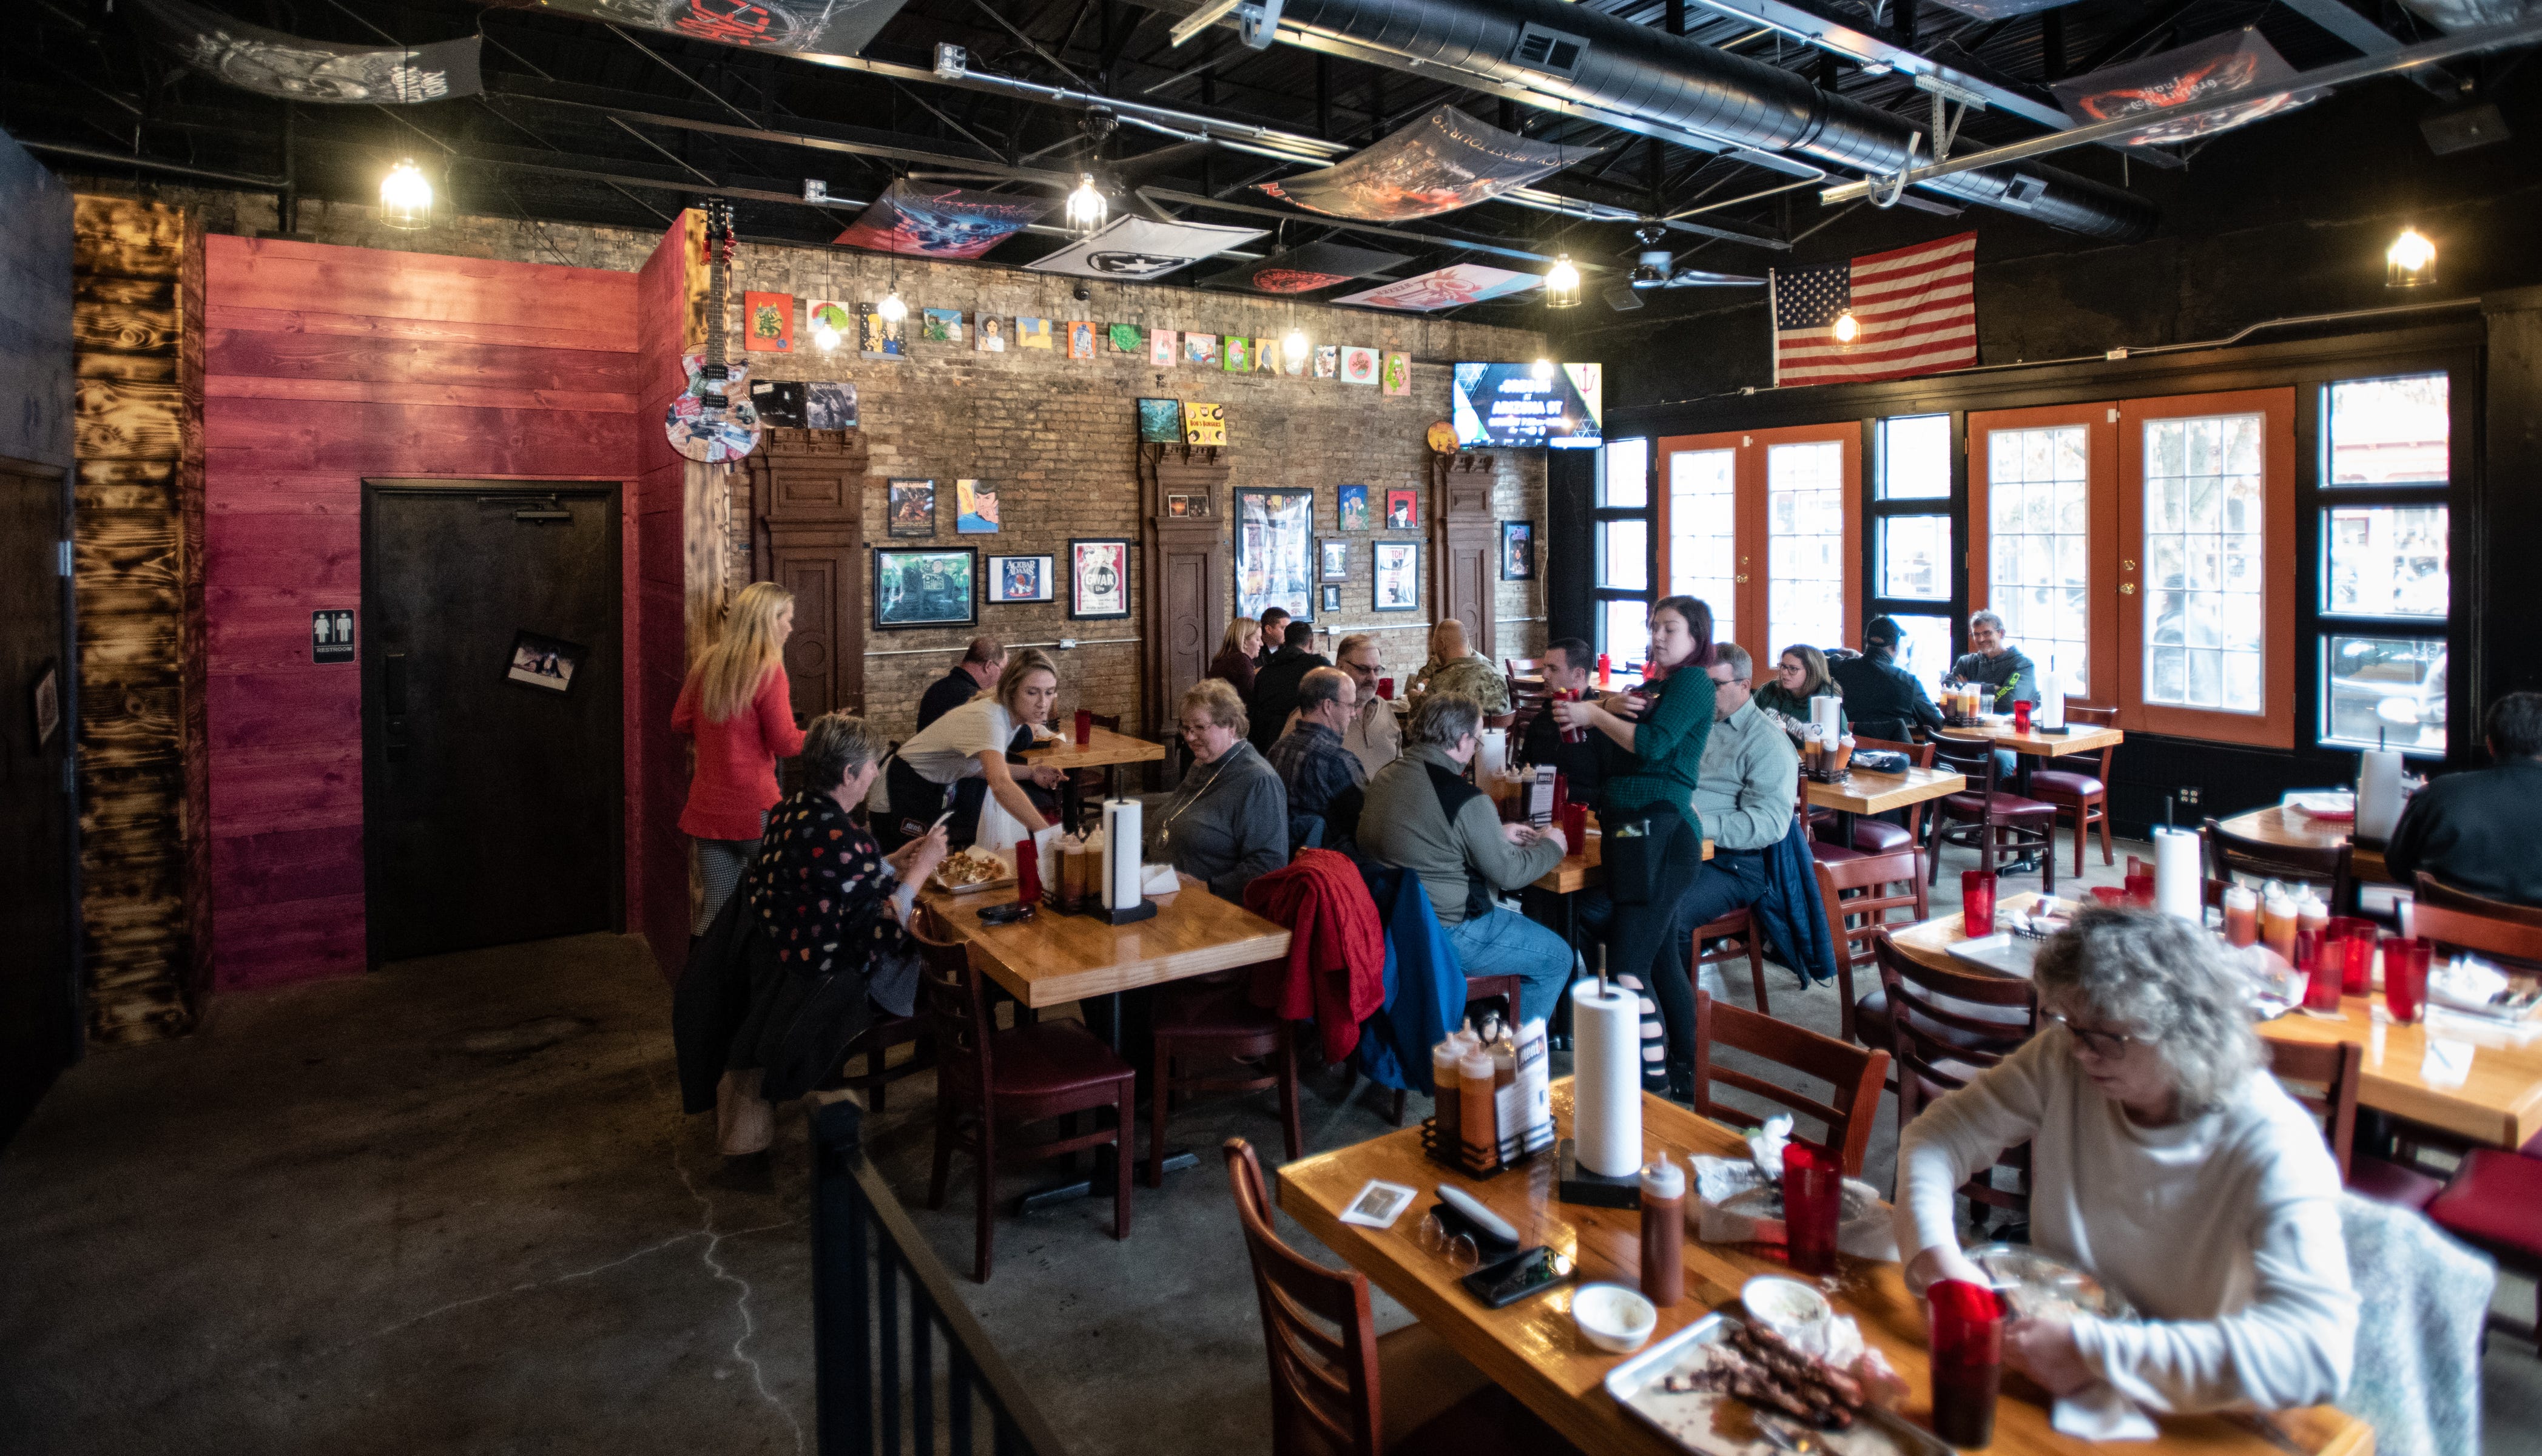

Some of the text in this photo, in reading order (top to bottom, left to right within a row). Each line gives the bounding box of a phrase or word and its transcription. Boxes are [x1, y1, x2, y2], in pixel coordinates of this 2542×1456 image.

[1450, 127, 1489, 152] TOUR
[1488, 146, 1532, 162] BEAST
[1375, 282, 1414, 295] WEEZER
[1006, 560, 1036, 570] ACKBAR
[1008, 567, 1034, 576] ADAMS
[1085, 574, 1114, 585] GWAR
